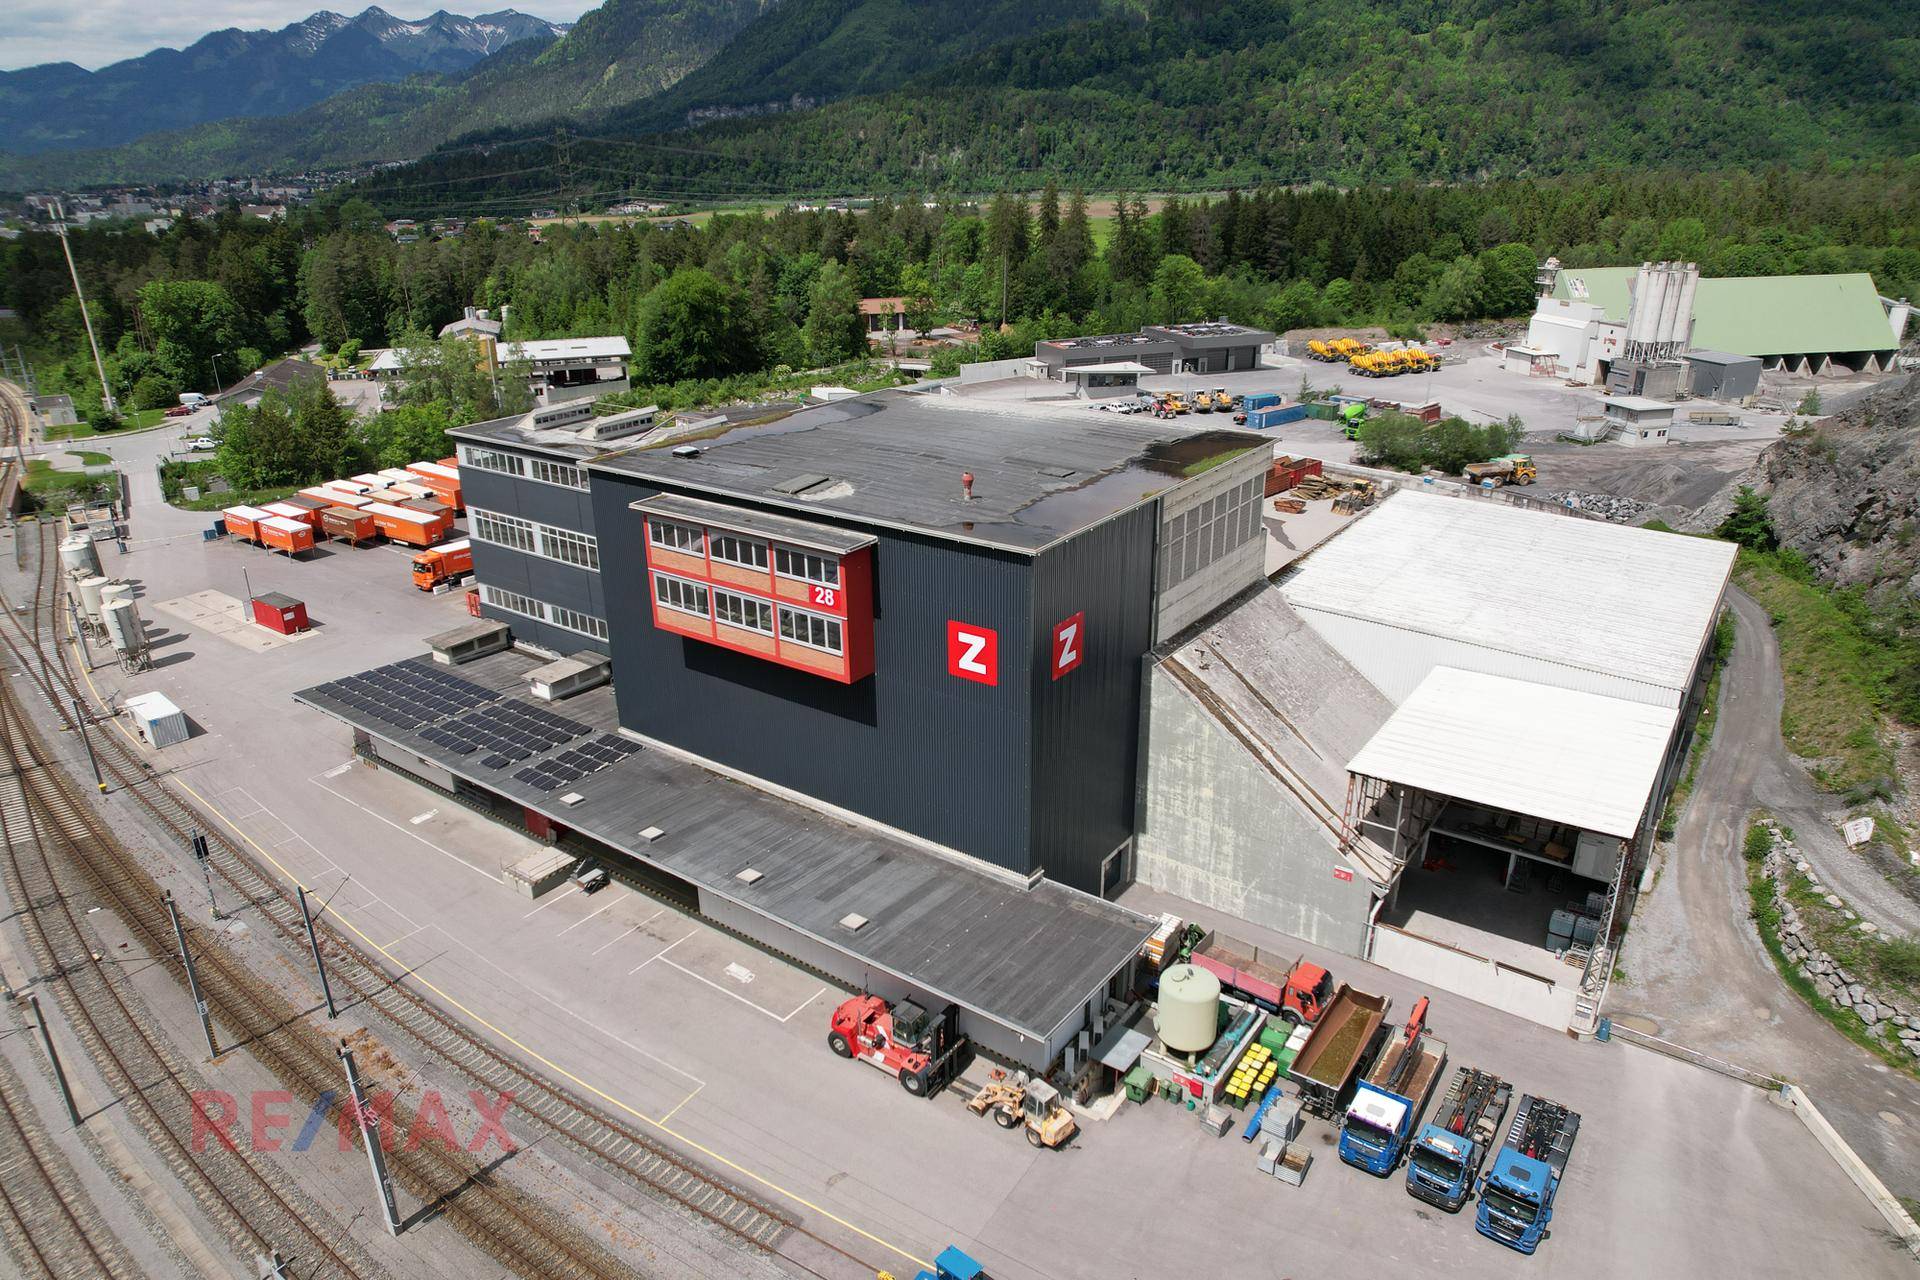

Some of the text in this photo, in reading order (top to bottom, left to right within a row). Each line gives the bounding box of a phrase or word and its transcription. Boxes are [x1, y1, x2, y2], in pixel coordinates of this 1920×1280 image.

[814, 586, 835, 607] 28
[957, 631, 987, 675] Z
[1058, 623, 1077, 669] Z
